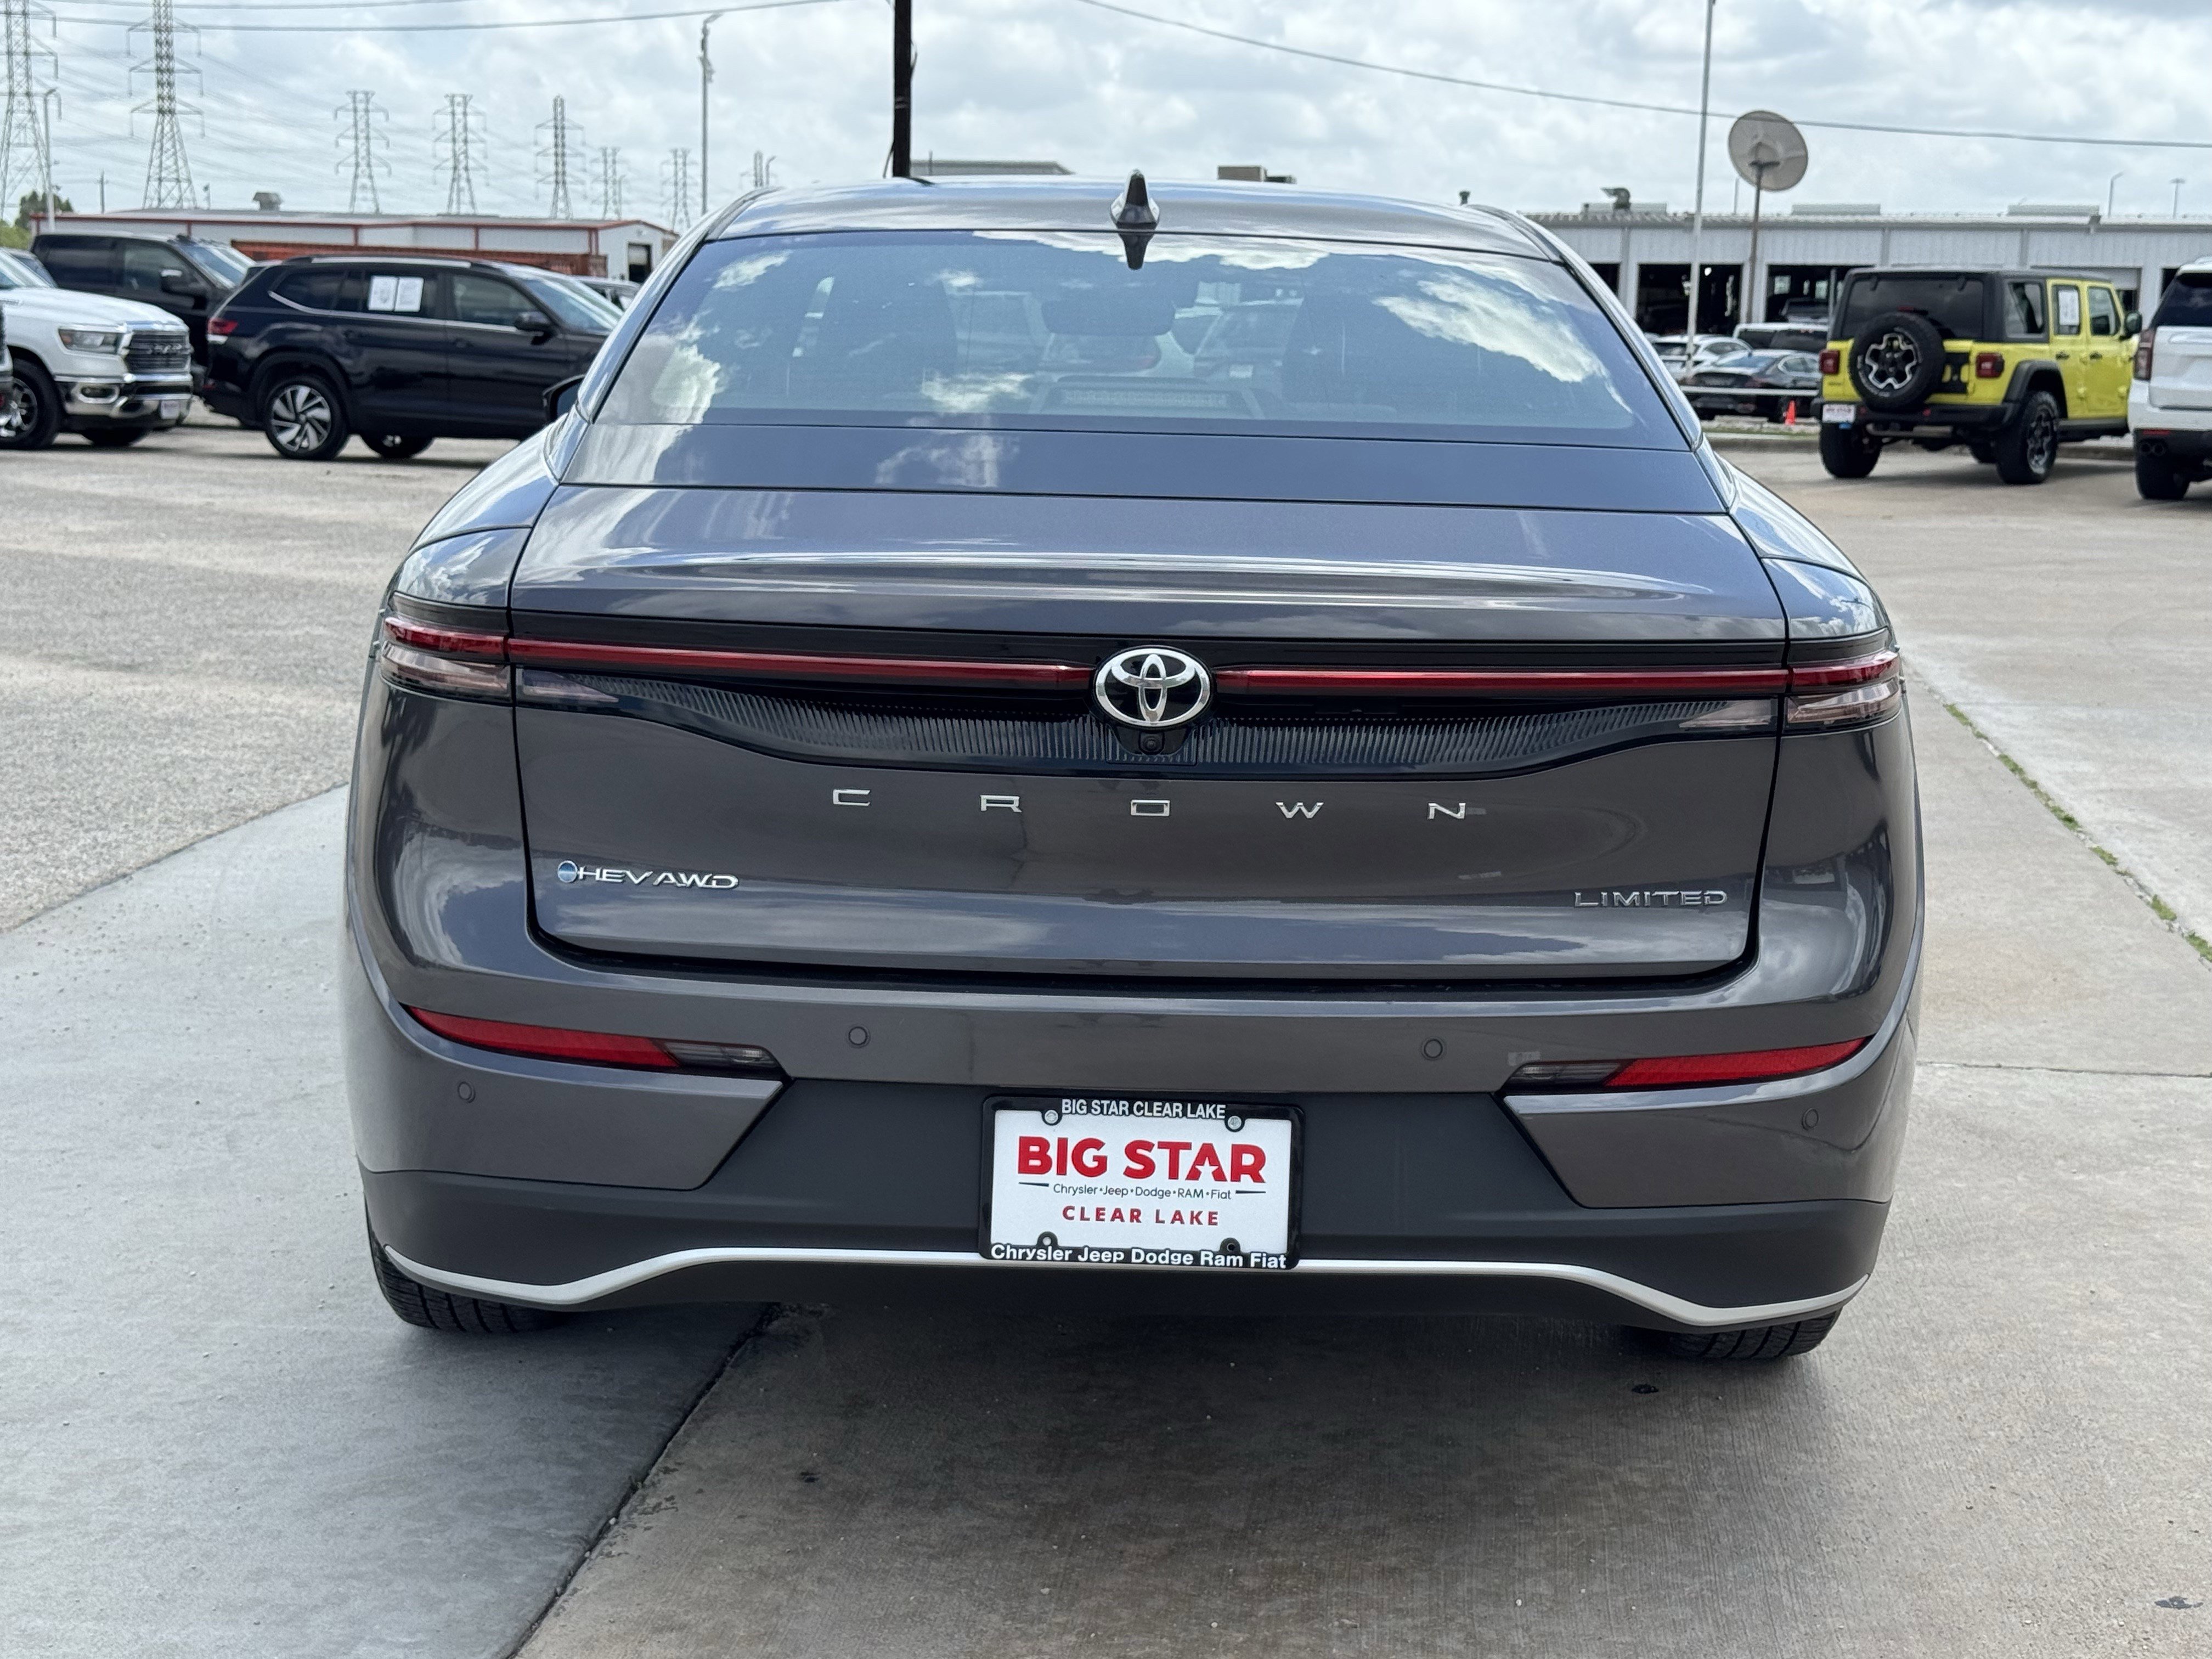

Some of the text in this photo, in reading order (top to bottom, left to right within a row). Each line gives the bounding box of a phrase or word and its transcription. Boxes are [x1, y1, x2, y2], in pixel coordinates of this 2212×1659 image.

[832, 788, 1466, 820] CROWN
[578, 865, 739, 889] HEV AWD
[1574, 890, 1728, 907] LIMITED
[1062, 1099, 1226, 1119] BIG STAR CLEAR LAKE
[1017, 1136, 1266, 1183] BIG STAR
[1053, 1183, 1232, 1200] Chrysler Jeep Dodge RAM Fiat
[1062, 1205, 1219, 1226] CLEAR LAKE
[991, 1244, 1287, 1269] Chrysler Jeep Dodge Ram Fiat
